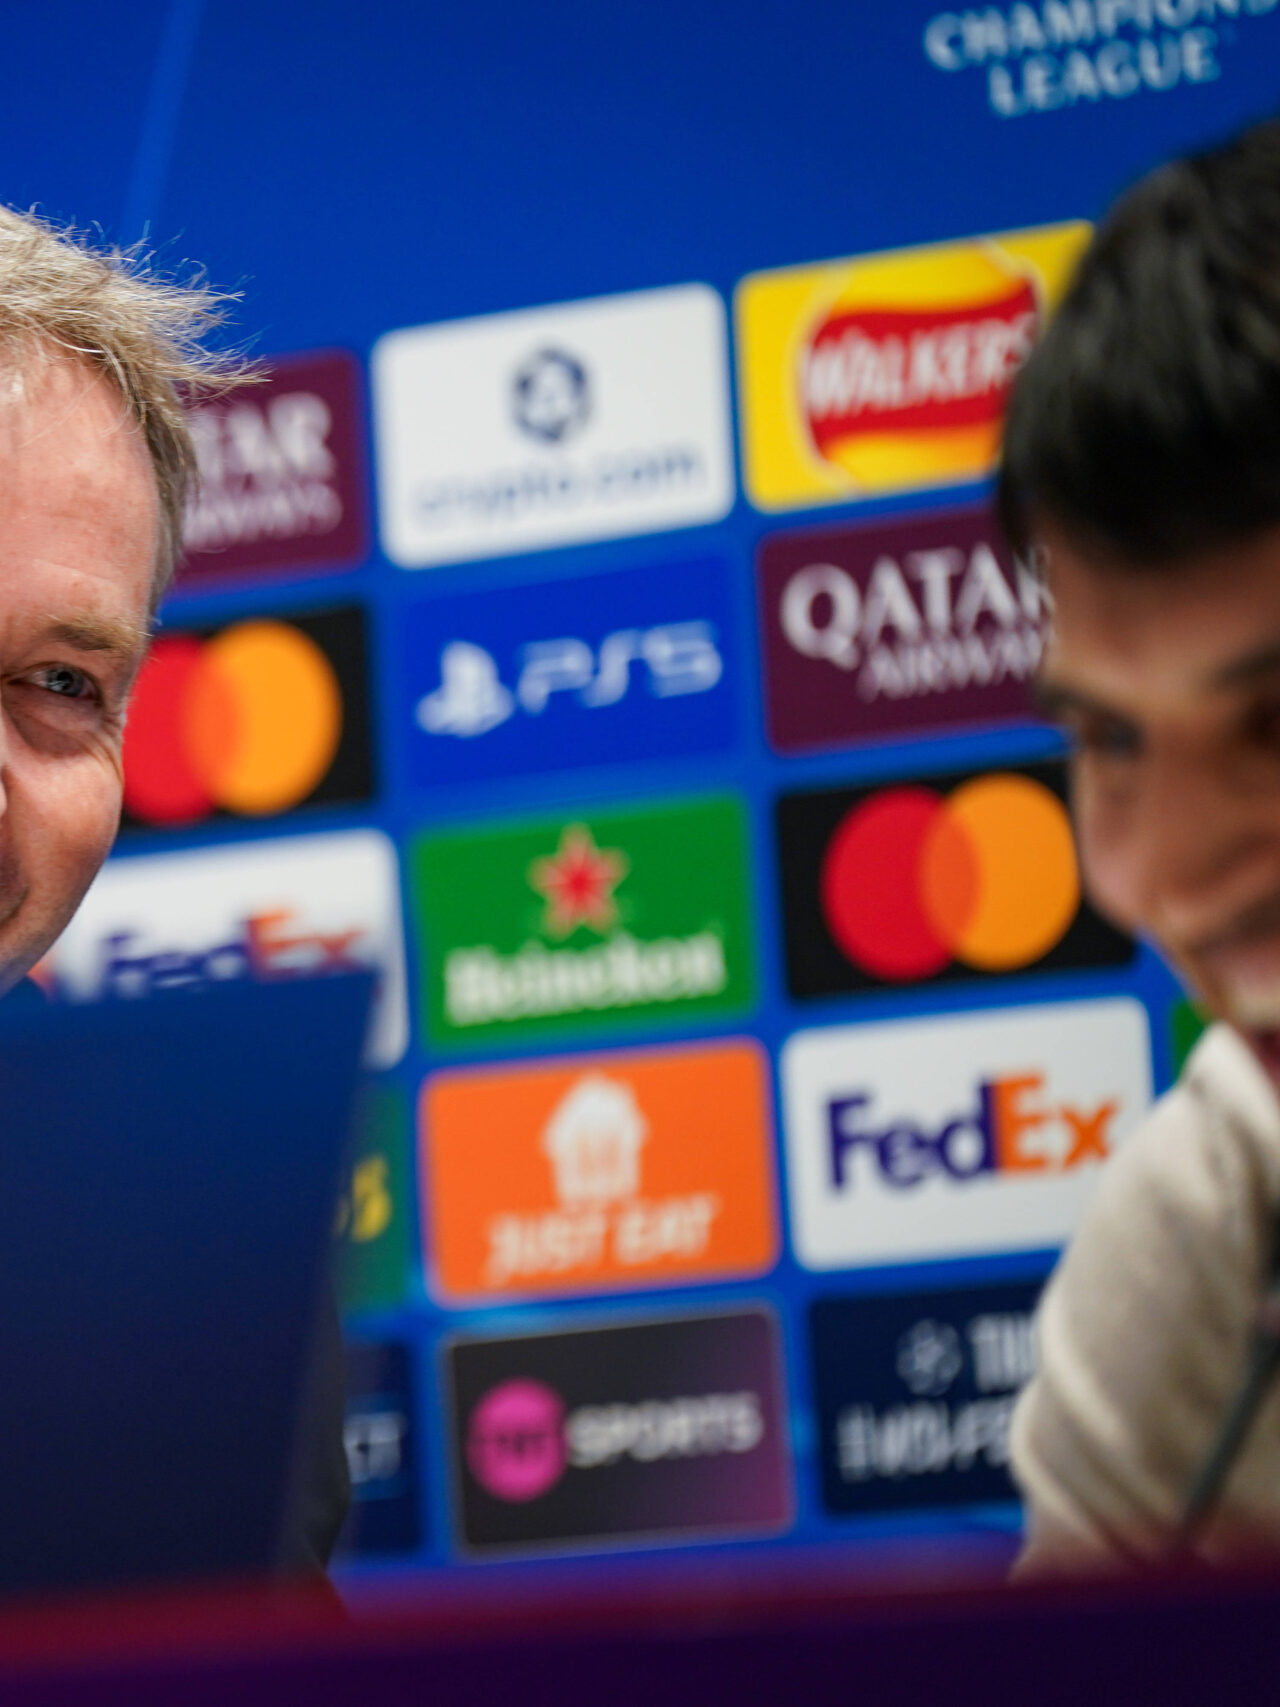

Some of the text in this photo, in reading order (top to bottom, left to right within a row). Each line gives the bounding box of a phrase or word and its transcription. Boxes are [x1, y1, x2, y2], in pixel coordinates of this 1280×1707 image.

[987, 26, 1220, 118] LEAGUE
[520, 619, 721, 714] PS5
[444, 930, 726, 1027] Heineken
[826, 1072, 1116, 1194] FedEx
[482, 1192, 723, 1286] JUST EAT
[567, 1392, 764, 1467] SPORTS
